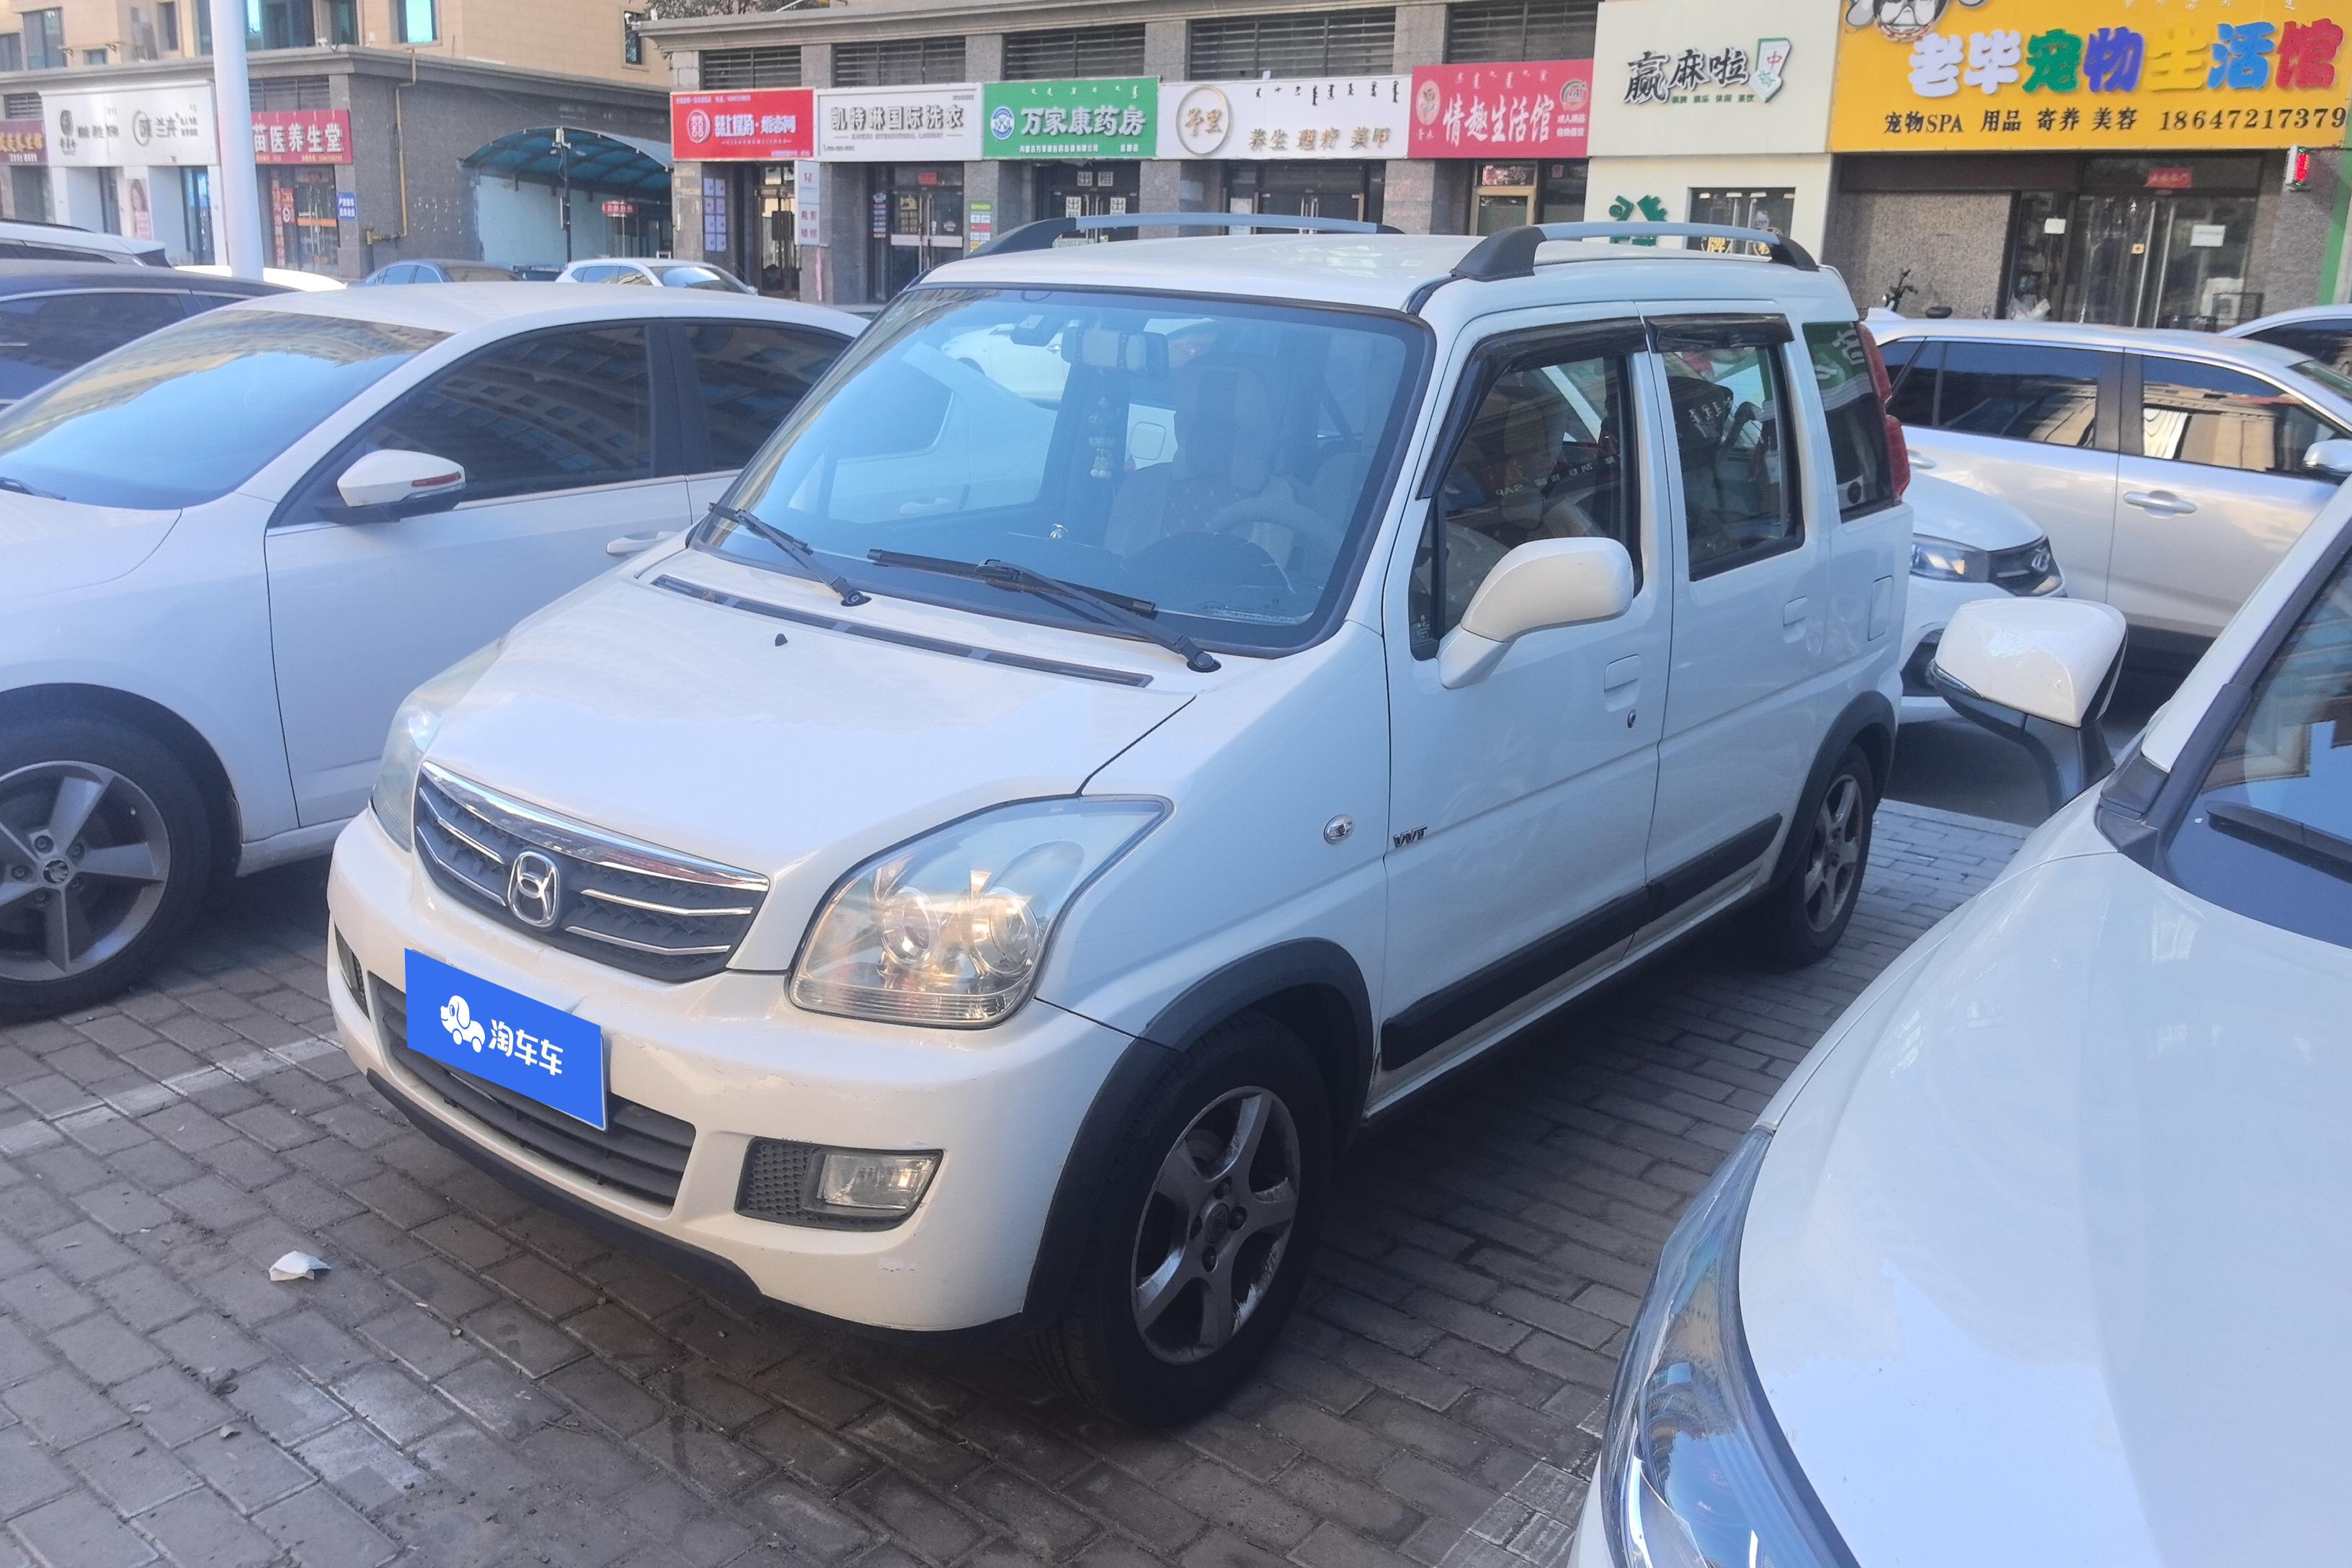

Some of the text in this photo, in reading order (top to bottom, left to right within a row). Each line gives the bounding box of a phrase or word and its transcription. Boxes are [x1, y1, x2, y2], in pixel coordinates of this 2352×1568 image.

[1908, 18, 2344, 97] 老毕宠物生活馆
[1623, 48, 1750, 104] 赢麻啦
[831, 105, 964, 131] 凯特琳国际洗衣
[1020, 105, 1147, 136] 万家康药房
[1443, 93, 1555, 147] 情趣生活馆
[1884, 107, 2347, 134] 宠物SPA 用品 寄养 美容 18647217379
[252, 122, 344, 153] 苗医养生堂
